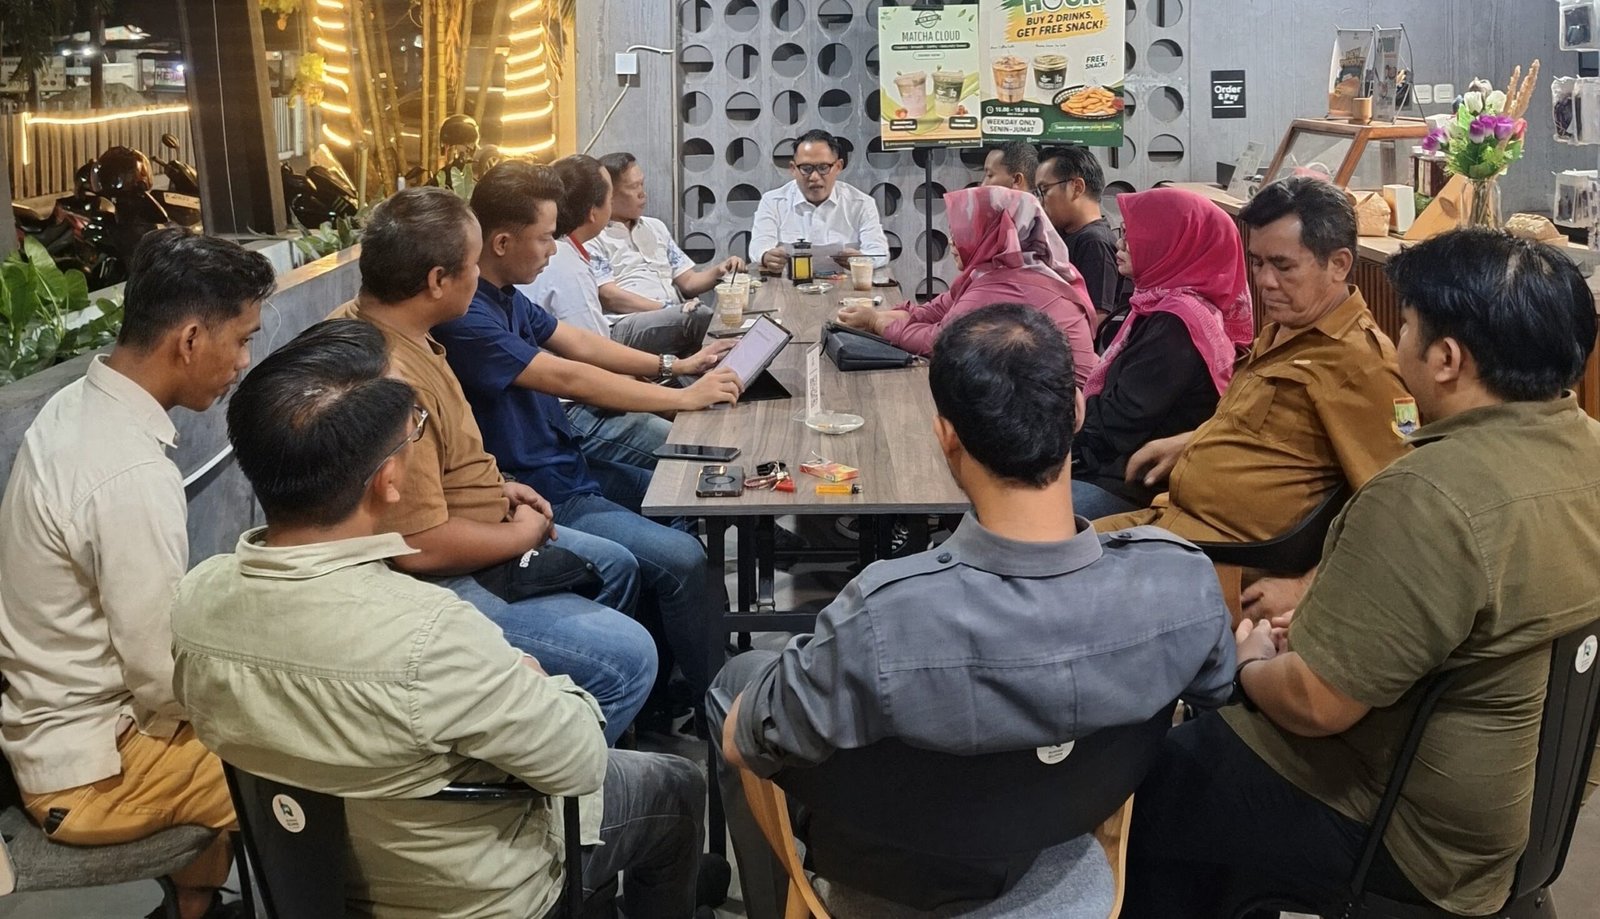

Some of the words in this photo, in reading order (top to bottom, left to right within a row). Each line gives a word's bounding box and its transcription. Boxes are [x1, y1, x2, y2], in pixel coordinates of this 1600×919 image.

[1026, 17, 1045, 25] BUY
[1047, 14, 1054, 23] 2
[1056, 11, 1093, 22] DRINKS,
[1016, 27, 1037, 38] GET
[1039, 24, 1063, 35] FREE
[1065, 20, 1103, 33] SNACK!
[902, 31, 933, 41] MATCHA
[935, 30, 960, 40] CLOUD
[1086, 54, 1105, 62] FREE
[1085, 62, 1108, 70] SNACK!
[1214, 85, 1243, 93] Order
[1218, 93, 1224, 101] &
[1224, 93, 1239, 101] Pay
[986, 118, 1018, 126] WEEKDAY
